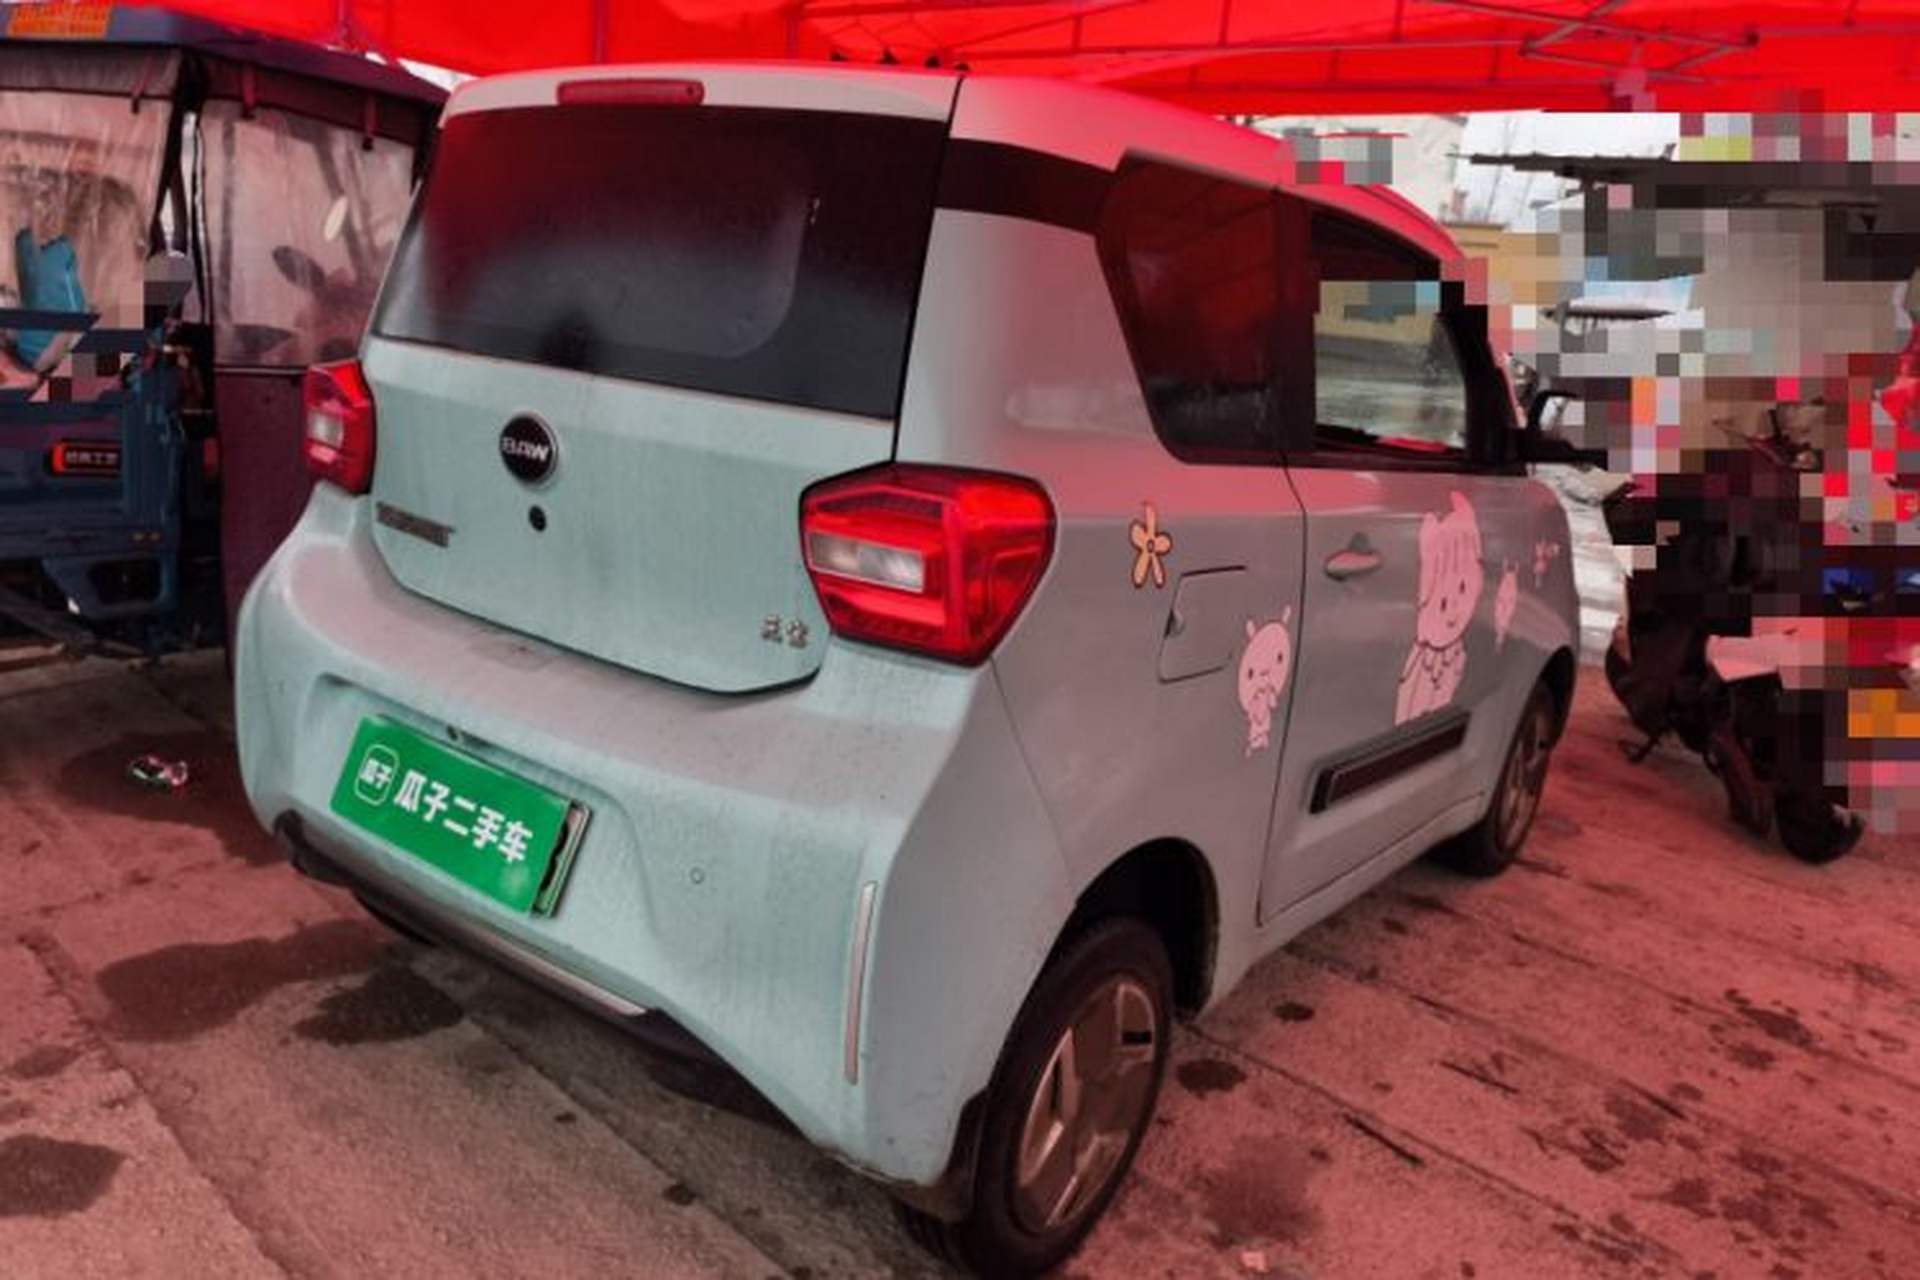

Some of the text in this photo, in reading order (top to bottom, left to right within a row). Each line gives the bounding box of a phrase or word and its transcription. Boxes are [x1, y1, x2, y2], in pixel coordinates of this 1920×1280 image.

[501, 436, 549, 462] BAW
[394, 769, 533, 863] 瓜子二手车
